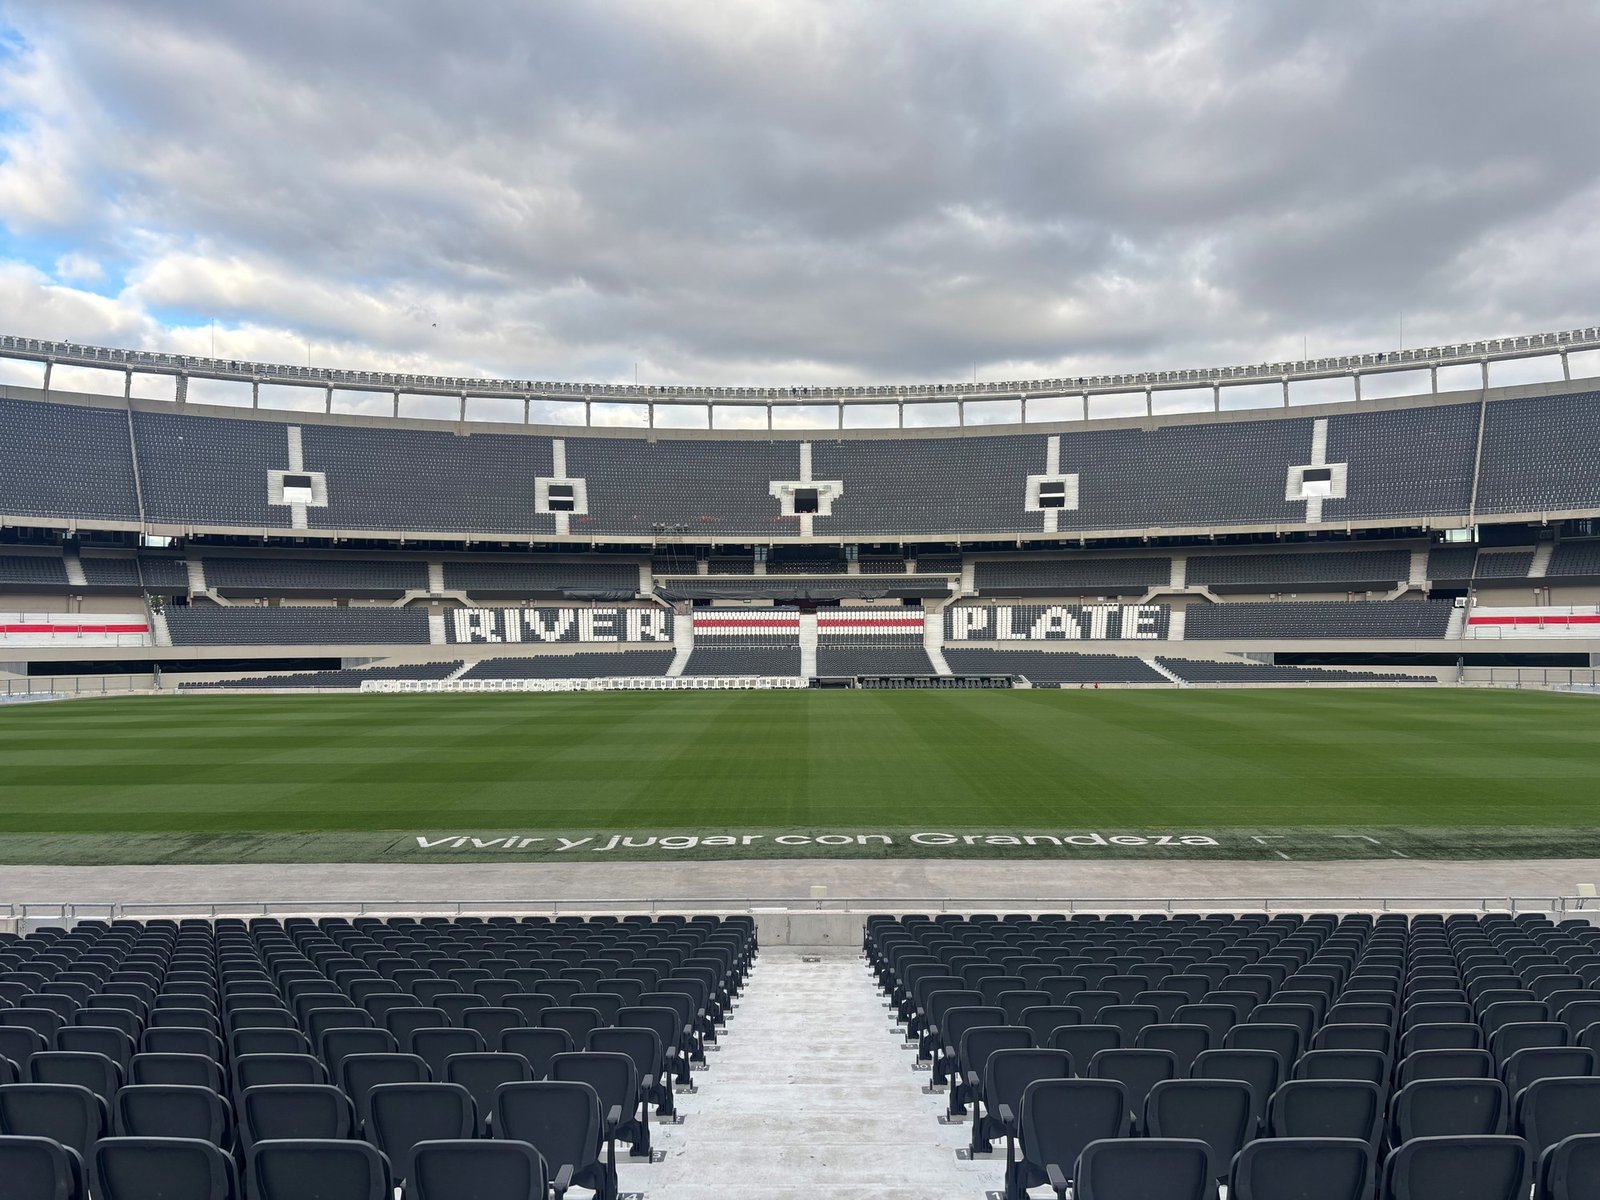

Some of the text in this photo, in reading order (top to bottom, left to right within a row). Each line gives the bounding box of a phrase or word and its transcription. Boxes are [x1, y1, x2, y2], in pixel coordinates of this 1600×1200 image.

[454, 605, 1160, 642] RIVER PLATE
[416, 832, 1220, 851] Vivir y jugar con Grandeza
